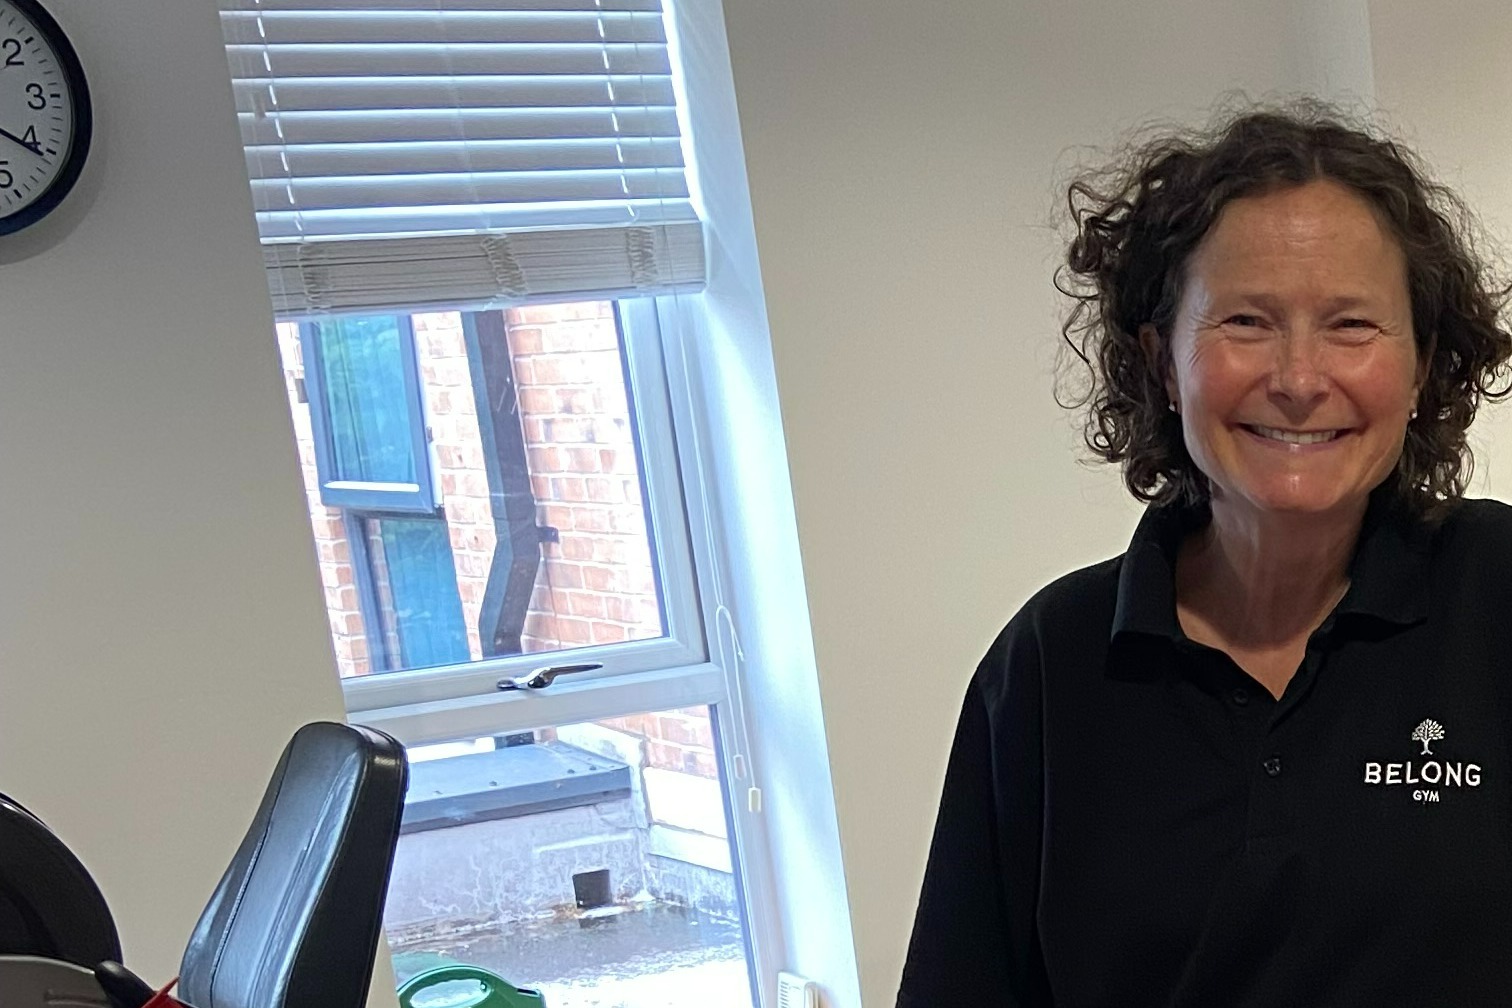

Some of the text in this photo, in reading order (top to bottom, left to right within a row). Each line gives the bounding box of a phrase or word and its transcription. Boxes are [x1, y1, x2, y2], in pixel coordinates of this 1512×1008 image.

[2, 38, 25, 66] 2
[25, 83, 47, 110] 3
[22, 125, 41, 149] 4
[1364, 761, 1482, 787] BELONG
[1412, 789, 1440, 802] GYM
